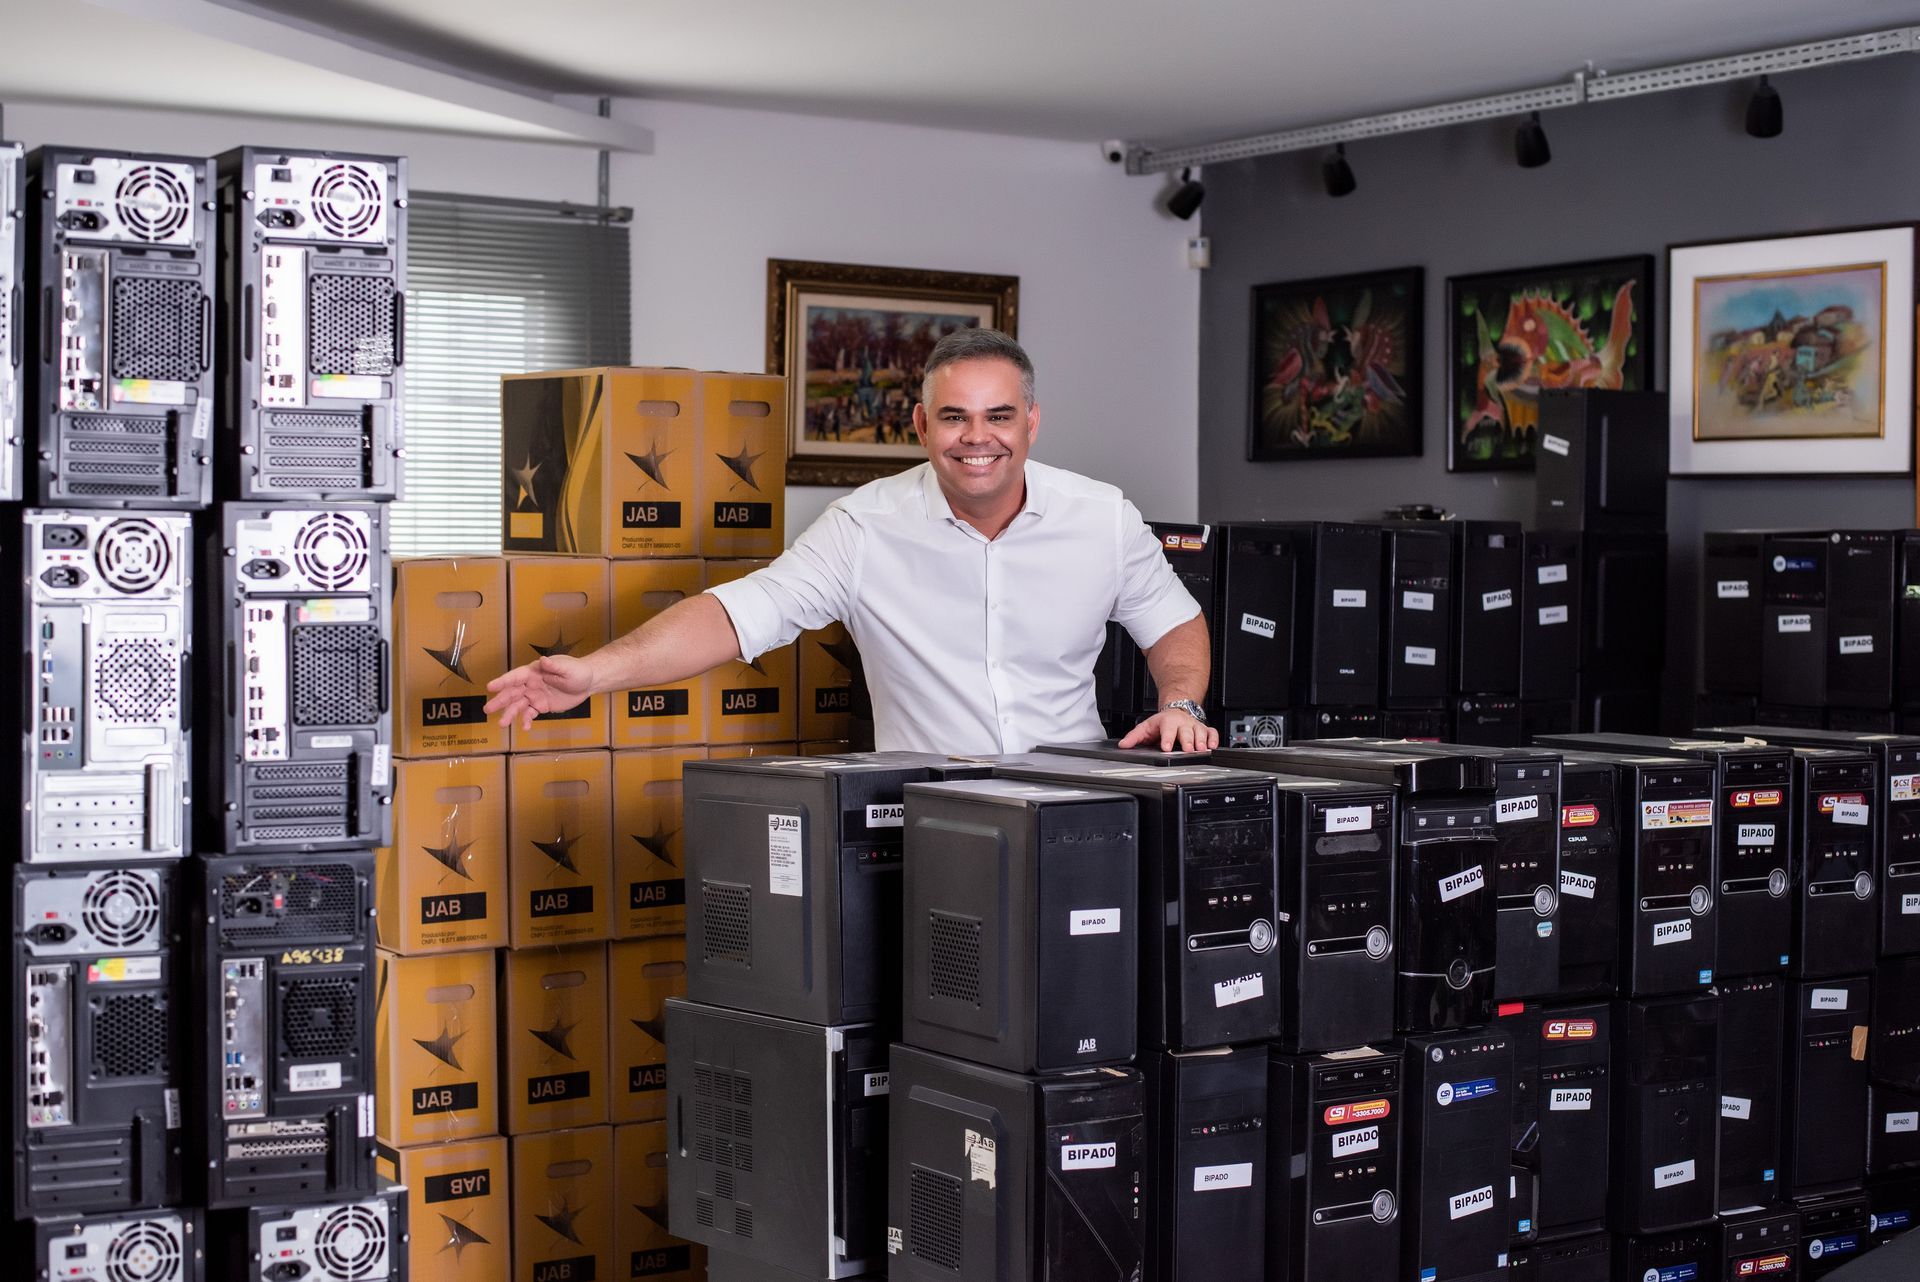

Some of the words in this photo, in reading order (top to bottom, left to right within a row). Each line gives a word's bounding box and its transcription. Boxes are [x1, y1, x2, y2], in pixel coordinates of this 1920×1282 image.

[626, 506, 658, 522] JAB
[718, 507, 750, 523] JAB
[1486, 592, 1512, 604] BIPADO
[1246, 617, 1275, 631] BIPADO
[1843, 639, 1873, 647] BIPADO
[631, 695, 665, 712] JAB
[725, 694, 757, 710] JAB
[426, 702, 462, 720] JAB
[871, 808, 904, 819] BIPAD
[1501, 799, 1538, 814] BIPADO
[1652, 806, 1666, 814] CSI
[780, 819, 798, 828] JAB
[1336, 816, 1359, 824] BIPADO
[1741, 828, 1774, 837] BIPADO
[1445, 868, 1482, 892] BIPADO
[1561, 874, 1595, 890] BIPADO
[534, 893, 569, 911] JAB
[634, 886, 666, 903] JAB
[425, 900, 461, 918] JAB
[1081, 918, 1106, 926] BIPADO
[1657, 922, 1691, 937] BIPADO
[1078, 1038, 1097, 1051] JAB
[532, 1079, 566, 1099] JAB
[870, 1076, 889, 1087] BIP
[416, 1090, 453, 1110] JAB
[1555, 1092, 1591, 1102] BIPADO
[1330, 1106, 1345, 1117] CSI
[1892, 1118, 1910, 1126] BIPADO
[1338, 1129, 1378, 1147] BIPADO
[1068, 1146, 1115, 1160] BIPADO
[1204, 1173, 1229, 1182] BIPADO
[1663, 1170, 1684, 1180] BIPADO
[450, 1175, 486, 1195] JAB
[1454, 1189, 1492, 1210] BIPADO
[635, 1253, 668, 1272] JAB
[537, 1263, 571, 1282] JAB
